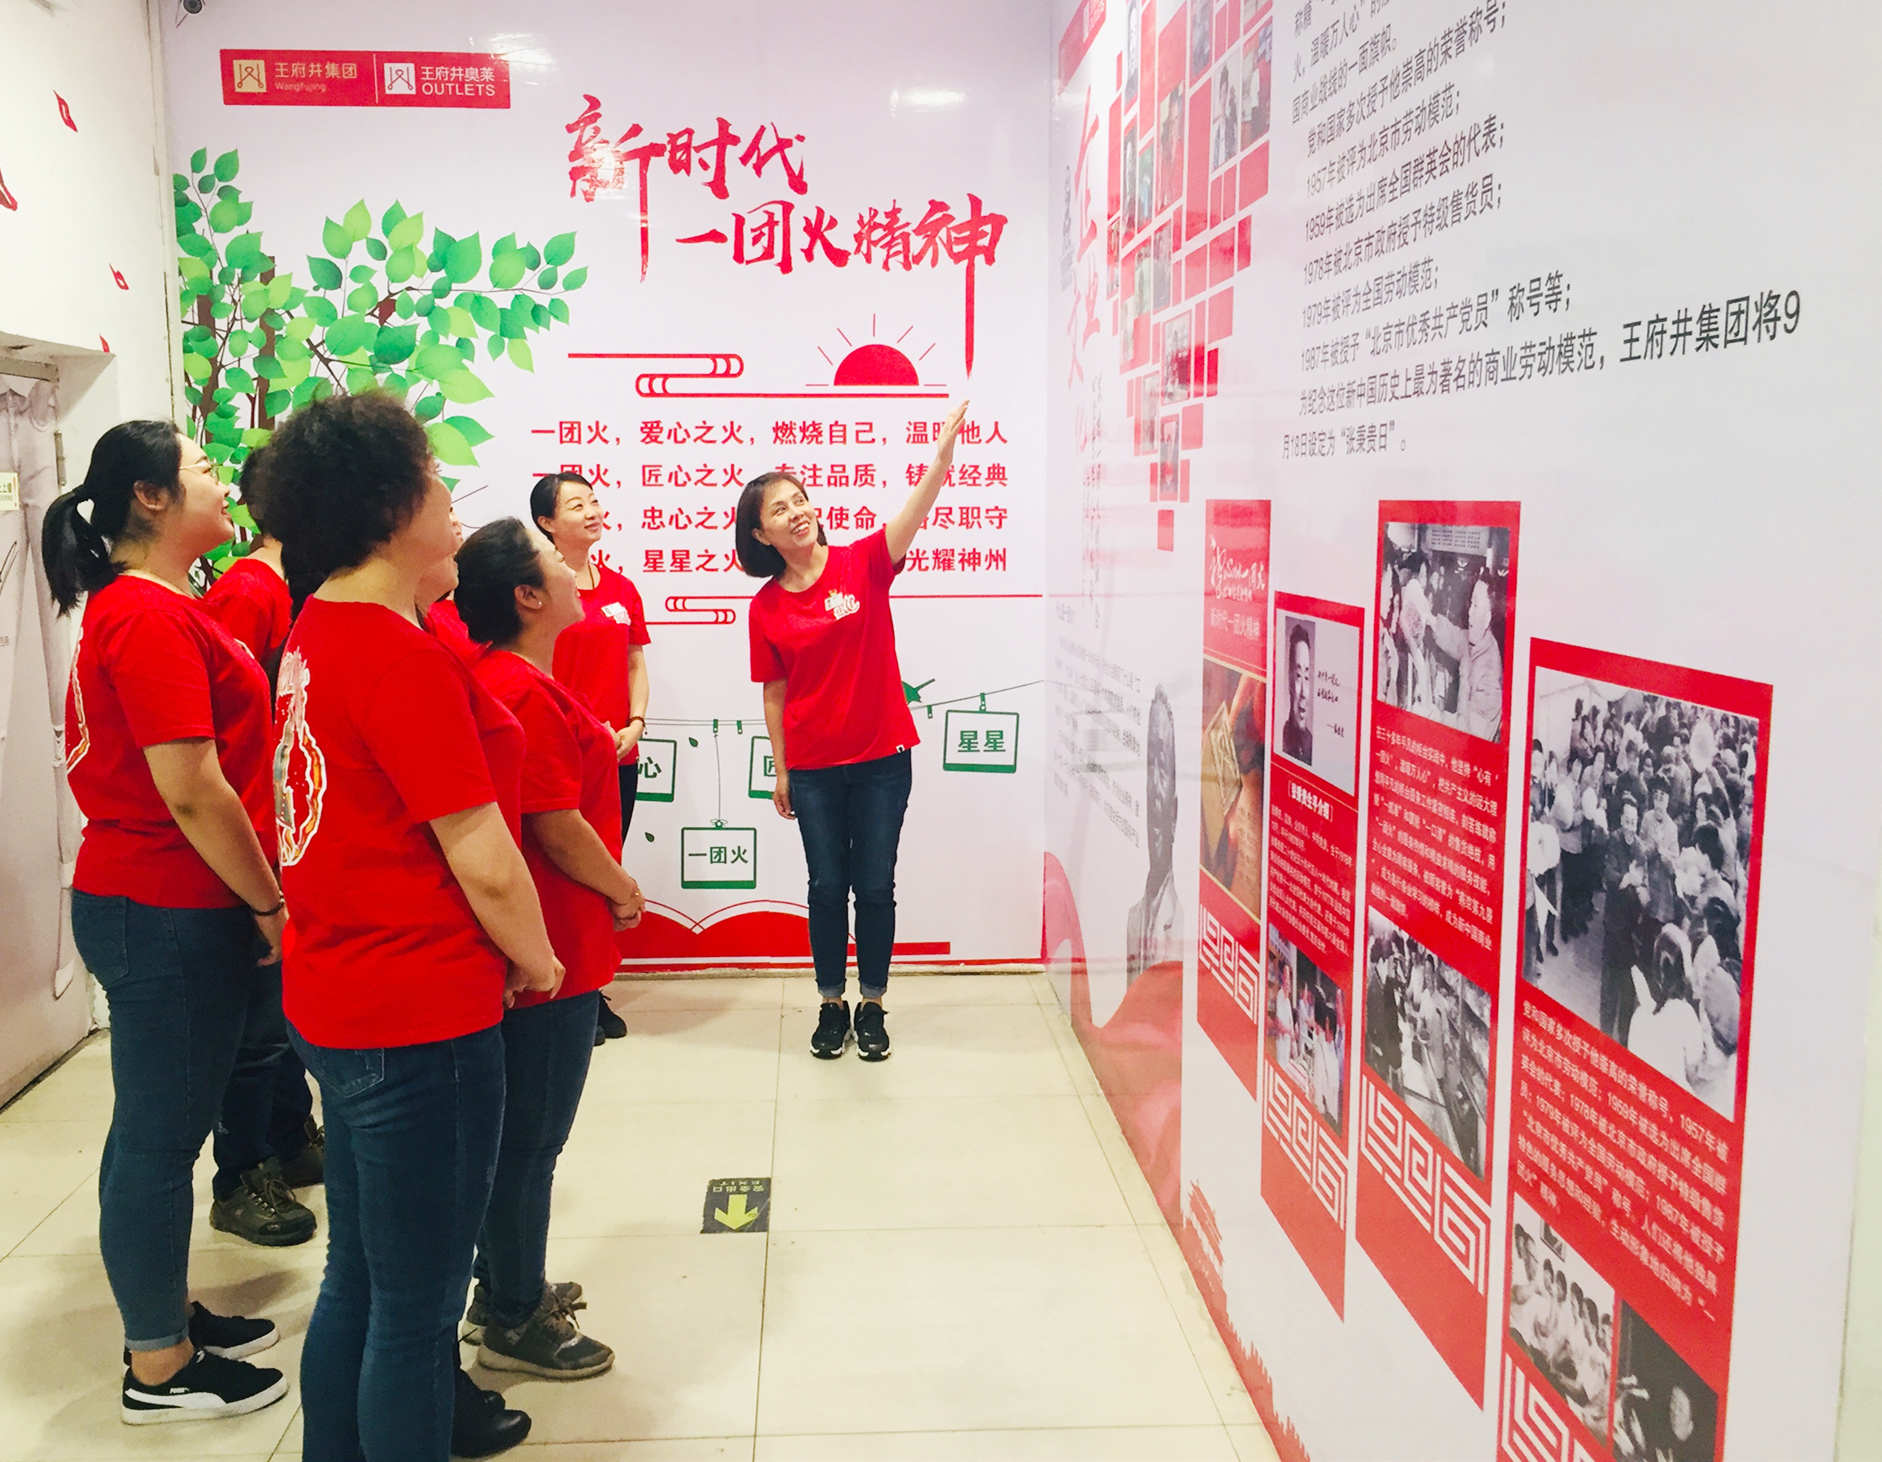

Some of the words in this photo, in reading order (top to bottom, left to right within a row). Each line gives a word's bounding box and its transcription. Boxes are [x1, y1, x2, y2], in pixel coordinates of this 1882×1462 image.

[275, 62, 357, 79] 王府井集团
[421, 66, 495, 82] 王府井奥莱
[275, 82, 326, 93] Wangfujing
[422, 83, 496, 96] OUTLETS
[565, 94, 808, 283] 新时代
[676, 192, 1008, 380] 一团火精神
[957, 730, 1006, 753] 星星
[688, 846, 749, 865] 一团火
